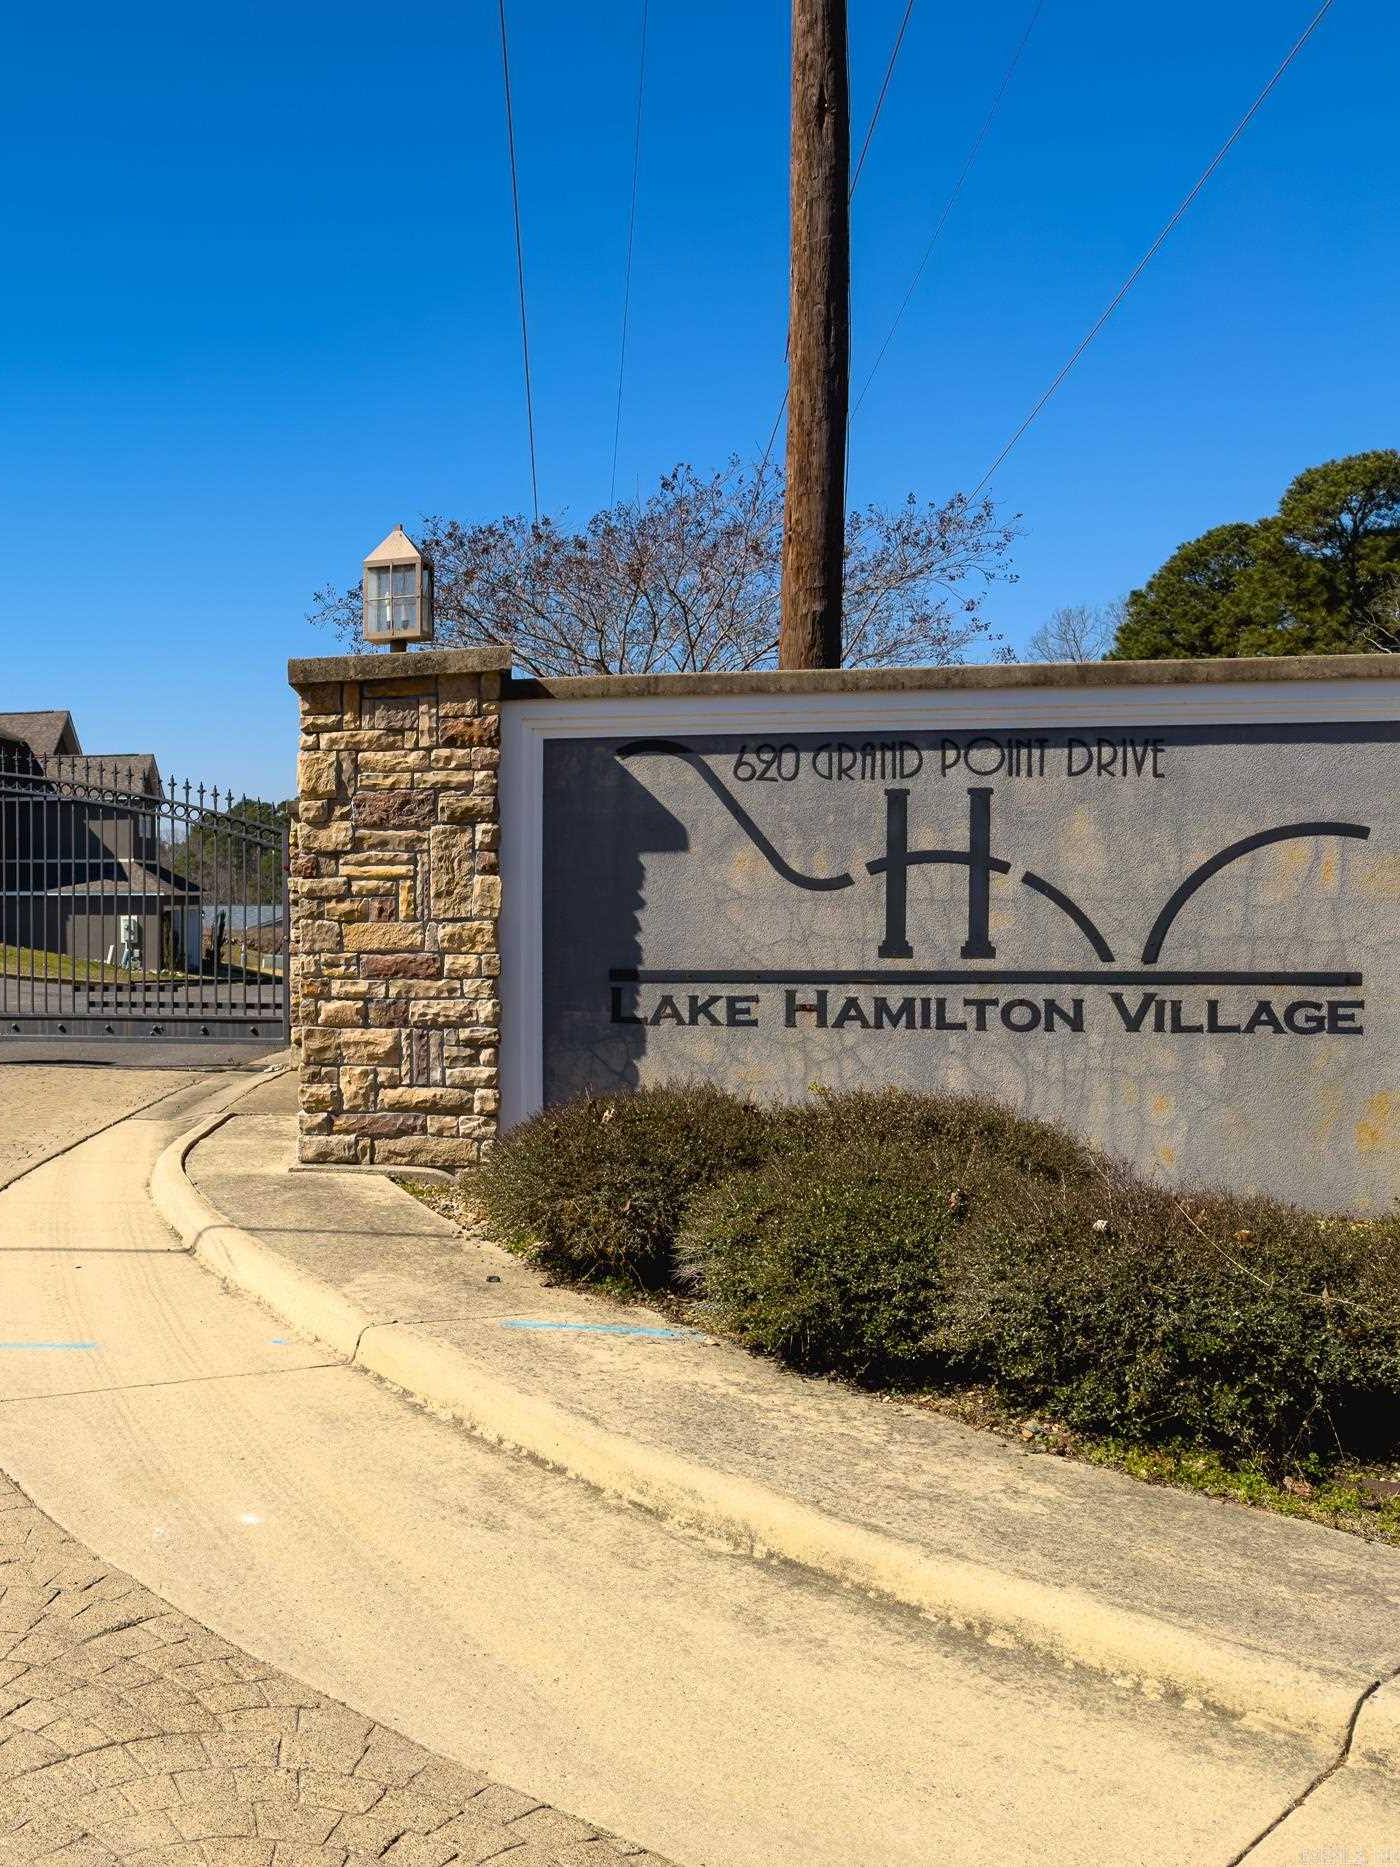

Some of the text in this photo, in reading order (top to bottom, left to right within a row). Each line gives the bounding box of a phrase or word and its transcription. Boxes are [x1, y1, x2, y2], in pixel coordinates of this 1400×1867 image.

[732, 736, 1166, 782] 620 GRAND POINT DRIVE
[609, 986, 1365, 1036] LAKE HAMILTON VILLAGE
